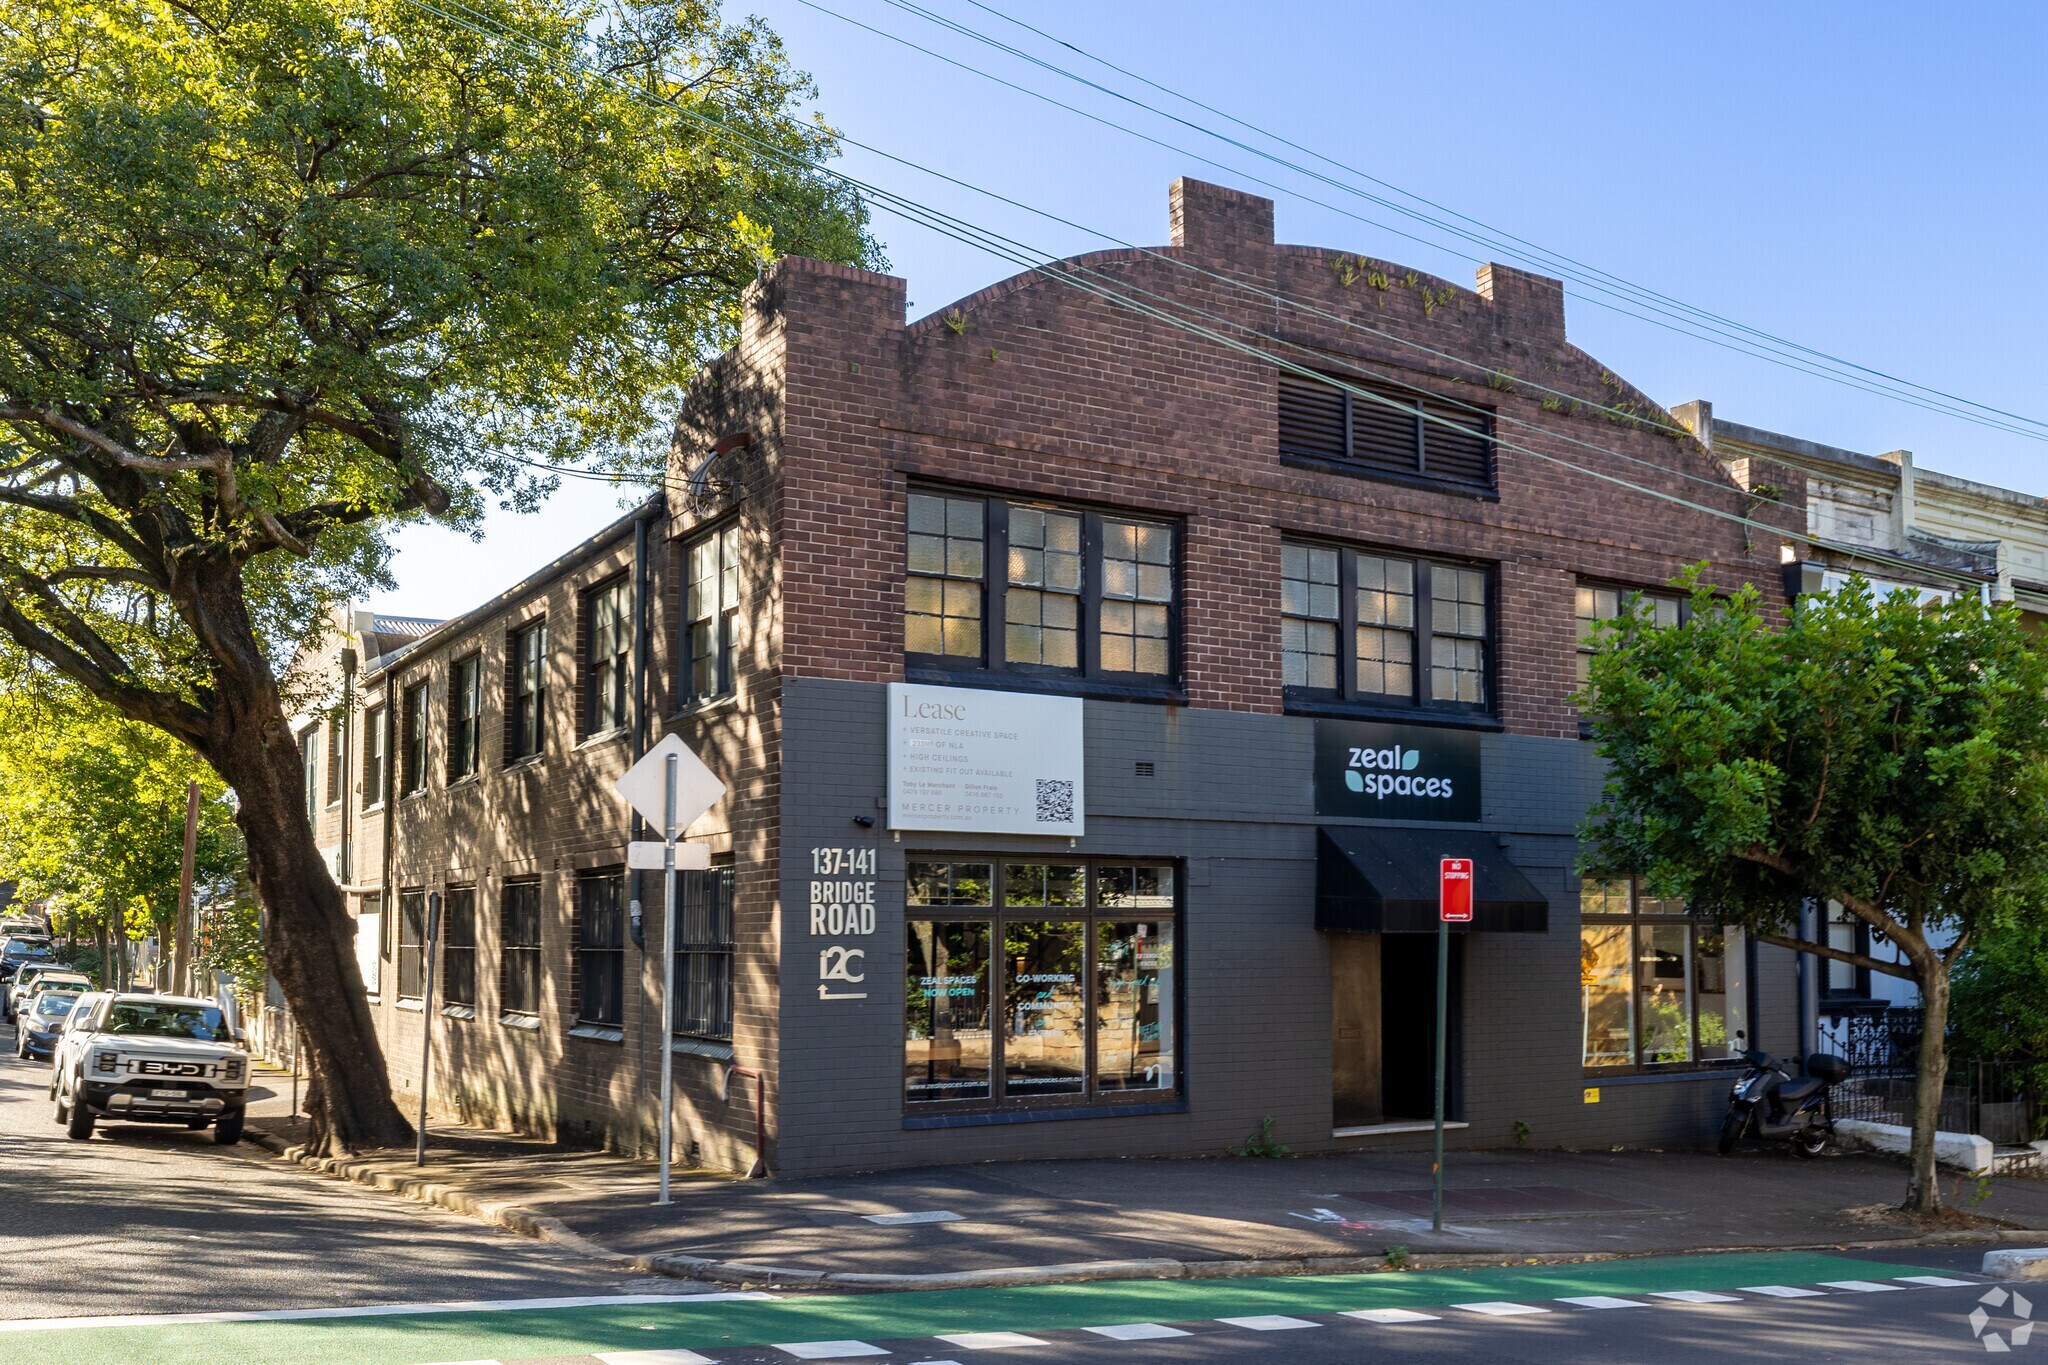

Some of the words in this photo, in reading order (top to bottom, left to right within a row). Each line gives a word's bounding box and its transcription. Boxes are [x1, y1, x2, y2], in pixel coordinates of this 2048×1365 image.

[902, 695, 966, 720] Lease
[910, 727, 952, 736] VERSATILE
[954, 729, 992, 738] CREATIVE
[994, 732, 1018, 740] SPACE
[932, 755, 968, 763] CEILINGS
[1349, 745, 1400, 770] zeal
[910, 766, 944, 774] EXISTING
[946, 767, 958, 775] FIT
[959, 768, 974, 776] OUT
[975, 769, 1013, 778] AVAILABLE
[1365, 773, 1453, 800] spaces
[902, 803, 951, 813] MERCER
[958, 804, 1020, 815] PROPERTY
[811, 847, 876, 875] 137-141
[1452, 862, 1461, 870] NO
[810, 881, 876, 903] BRIDGE
[810, 904, 876, 935] ROAD
[920, 977, 942, 985] ZEAL
[943, 975, 977, 985] SPACES
[1016, 974, 1075, 983] CO-WORKING
[923, 988, 948, 997] NOW
[948, 987, 975, 997] OPEN
[145, 1062, 199, 1075] BYD
